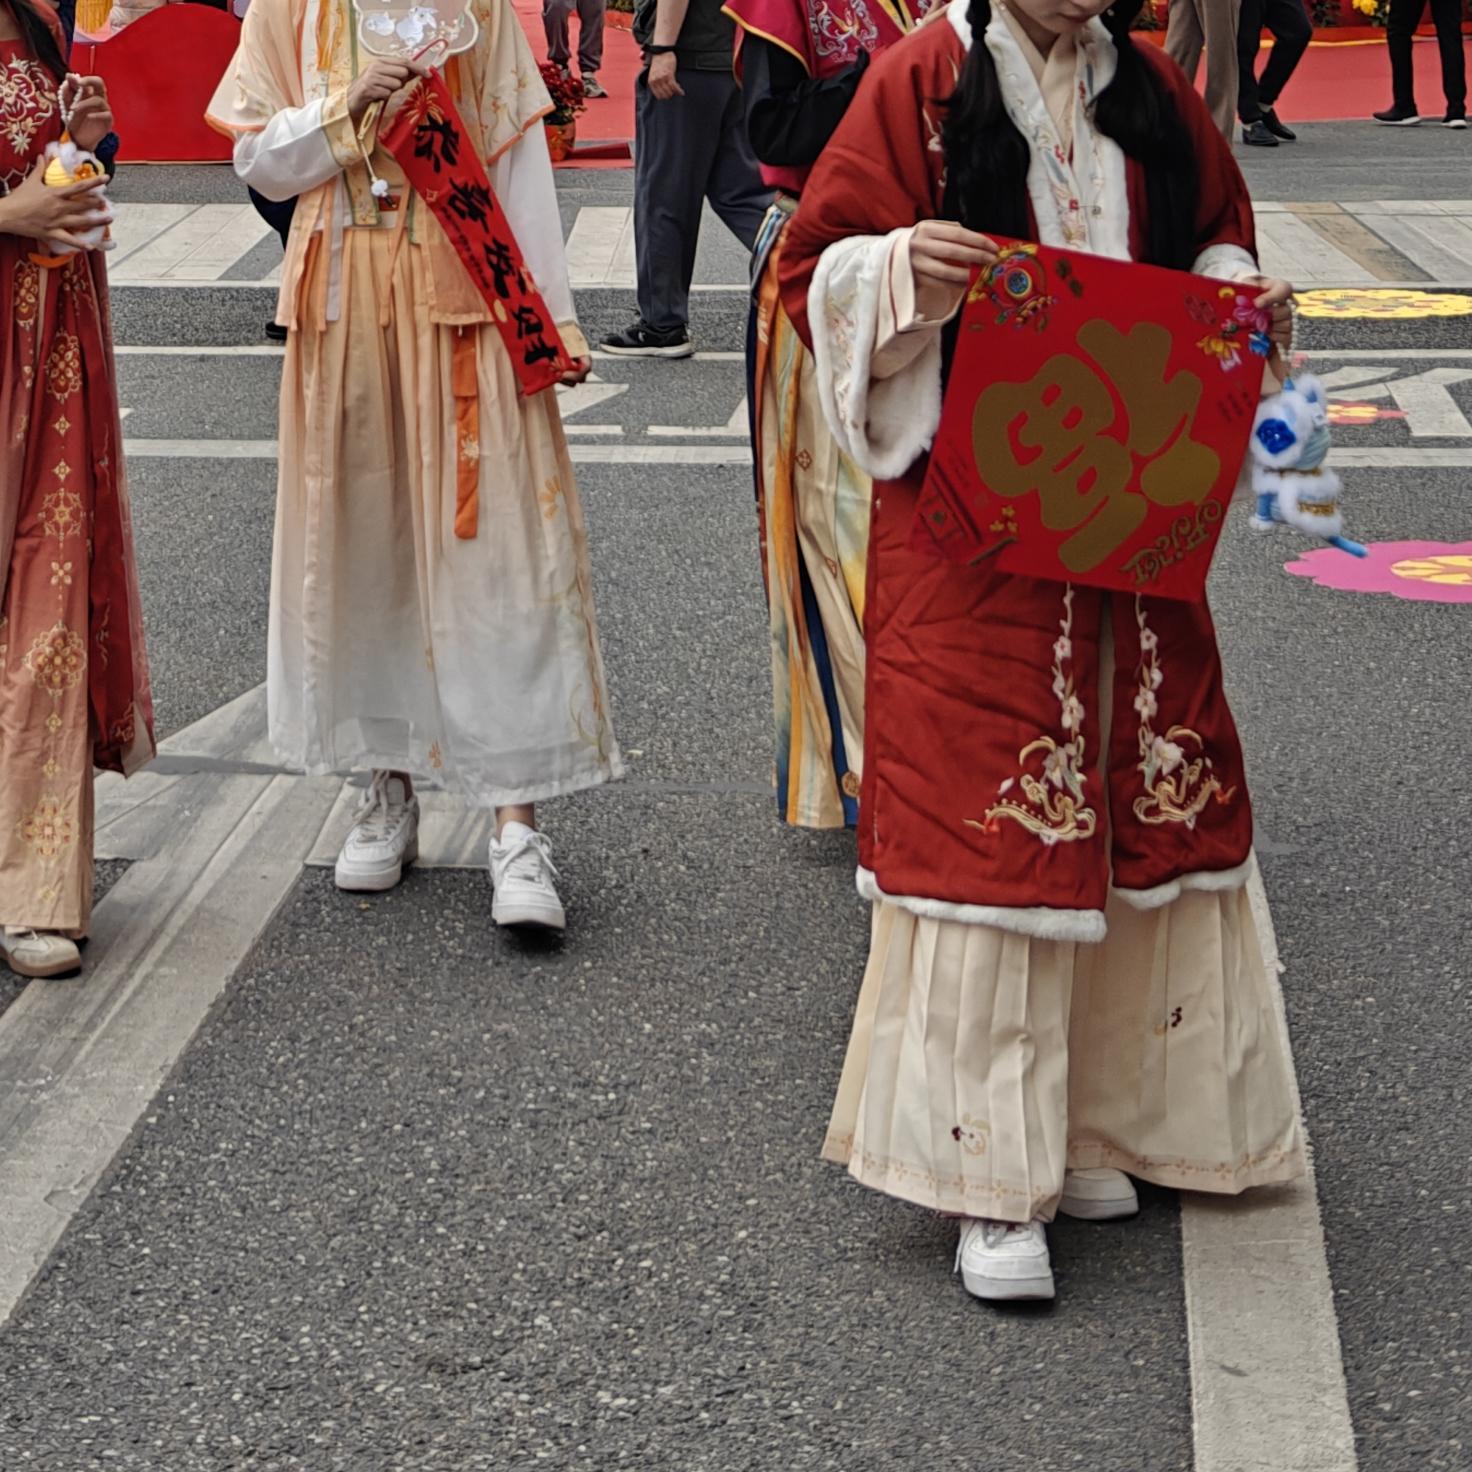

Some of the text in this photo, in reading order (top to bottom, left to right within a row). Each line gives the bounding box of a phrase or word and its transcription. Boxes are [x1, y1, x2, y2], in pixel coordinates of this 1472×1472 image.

[413, 112, 559, 366] 恭喜发财
[973, 319, 1220, 573] 福
